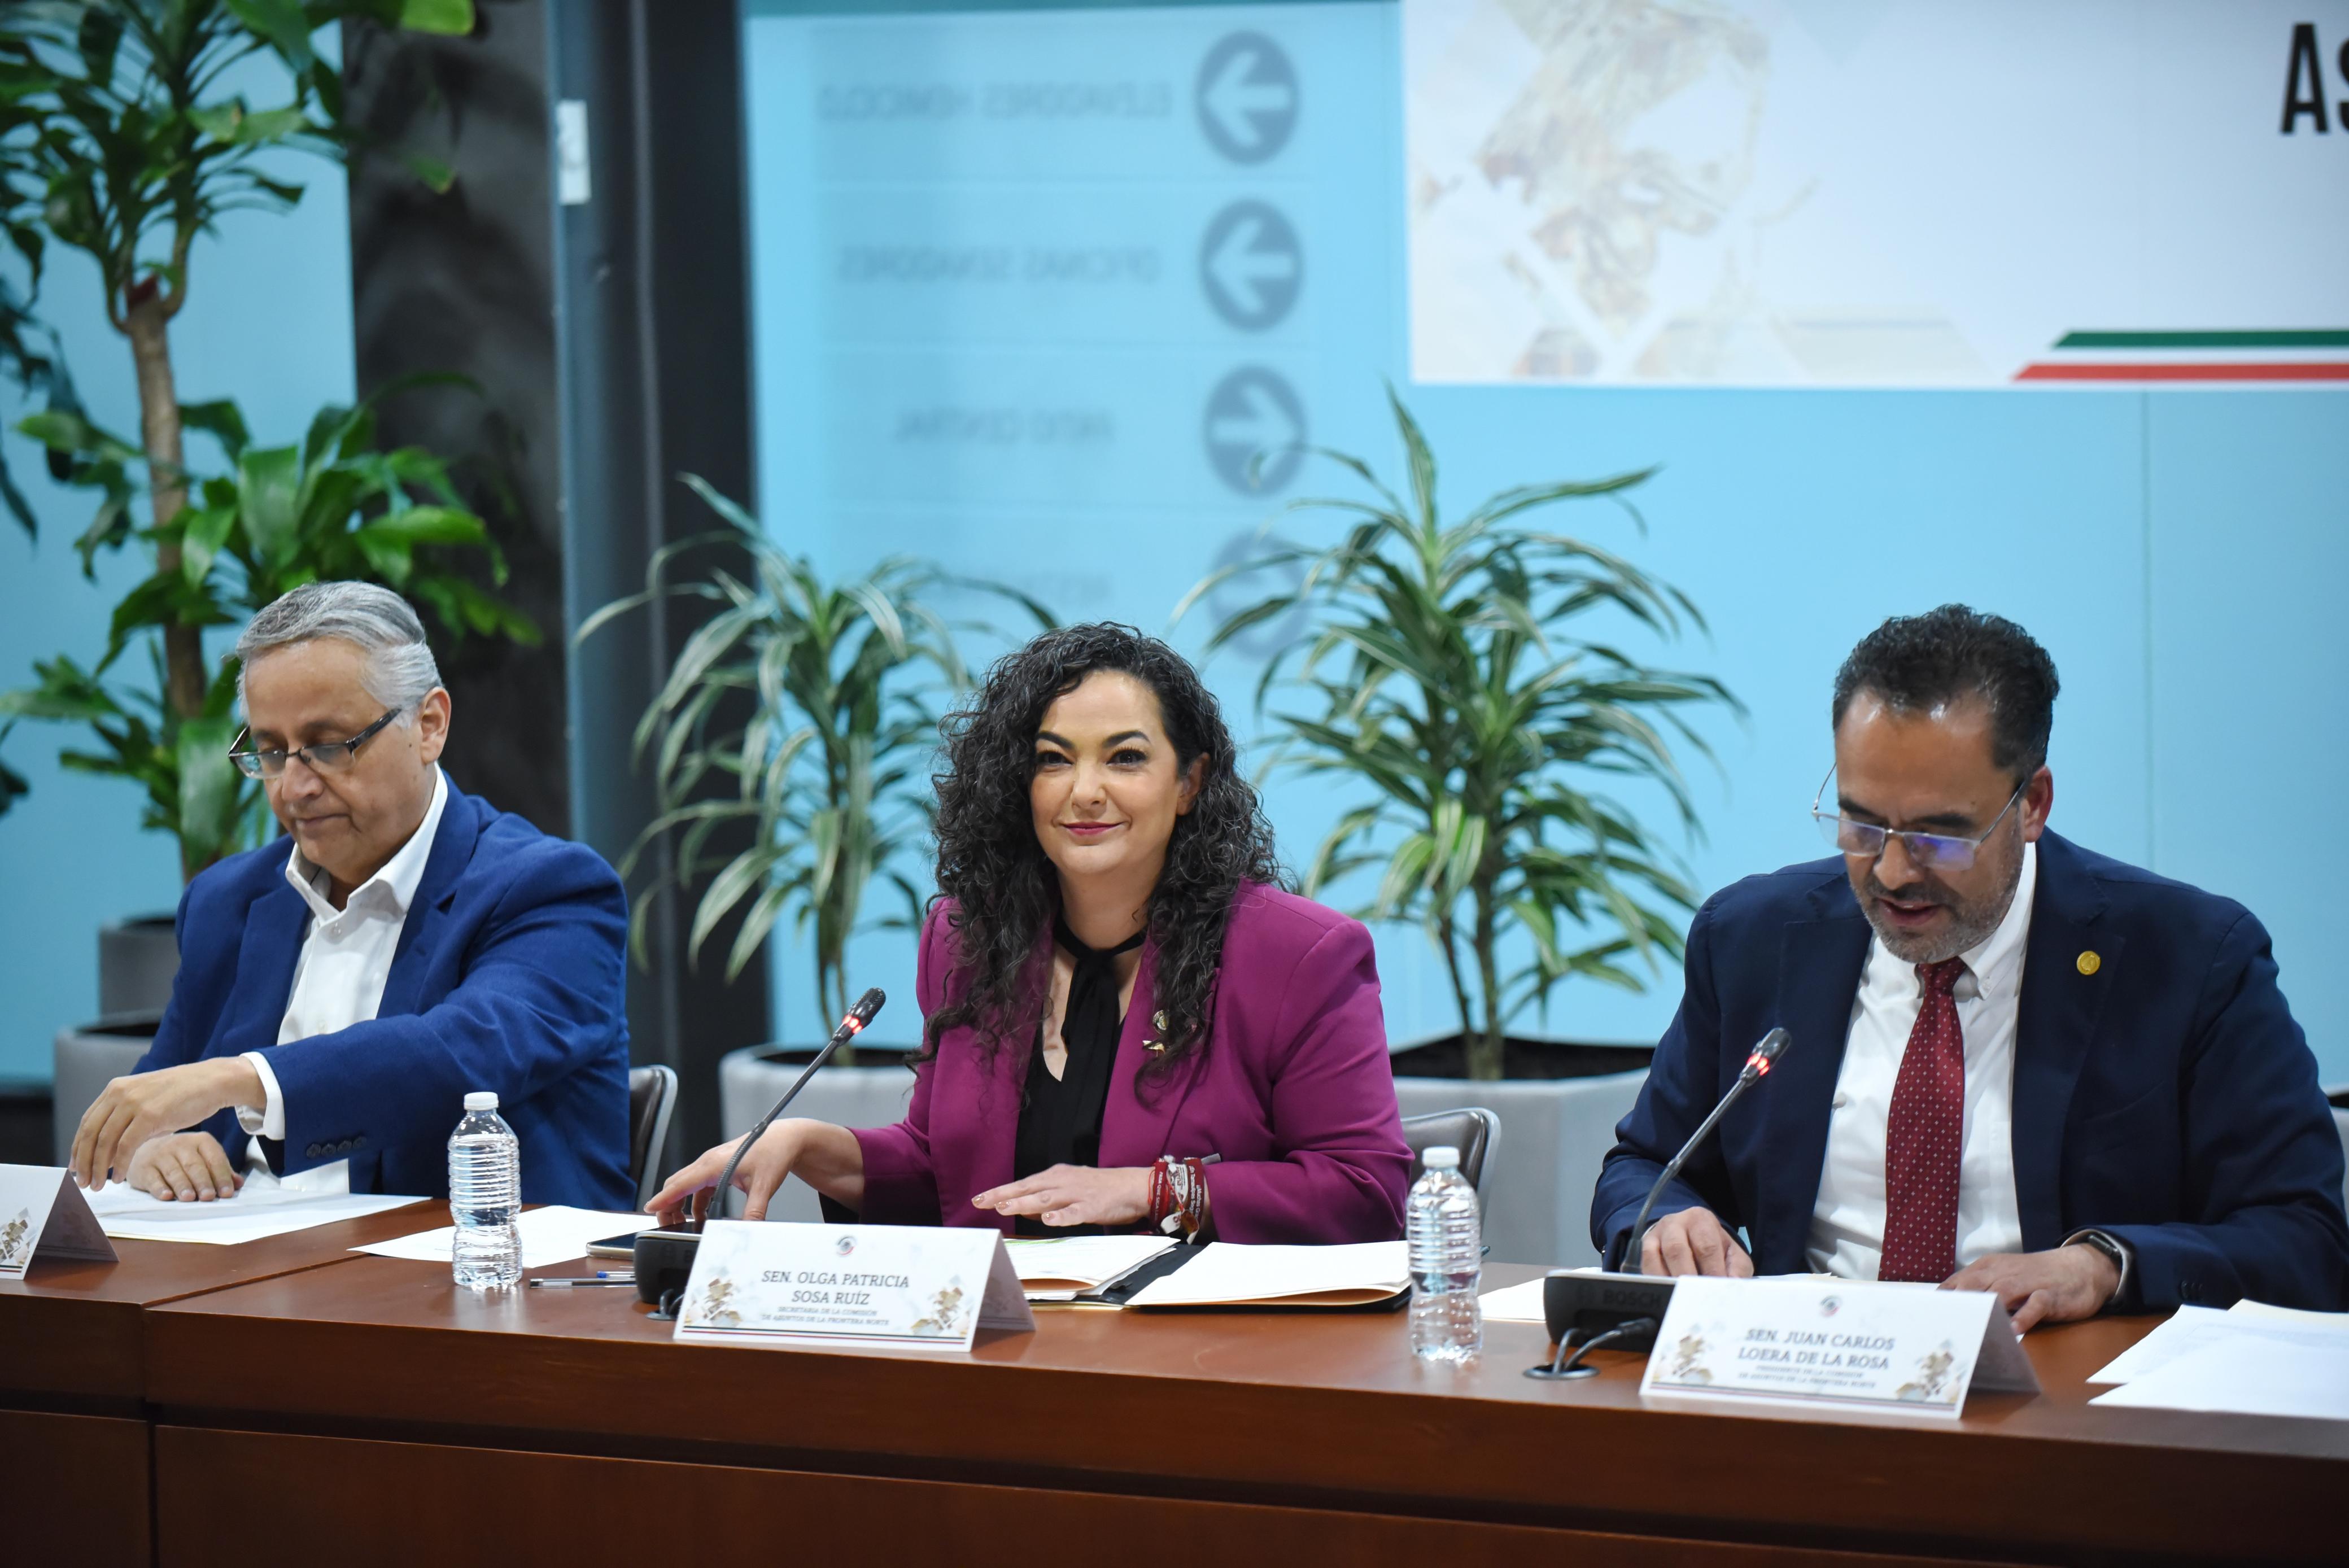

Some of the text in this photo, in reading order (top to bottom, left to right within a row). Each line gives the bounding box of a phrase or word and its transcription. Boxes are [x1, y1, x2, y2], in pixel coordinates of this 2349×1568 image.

[762, 1270, 910, 1288] SEN. OLGA PATRICIA
[792, 1290, 871, 1305] SOSA RUÍZ
[1603, 1289, 1662, 1309] BOSCH
[1784, 1330, 1828, 1346] JUAN
[1831, 1334, 1896, 1351] CARLOS
[1737, 1347, 1889, 1370] LOERA DE LA ROSA
